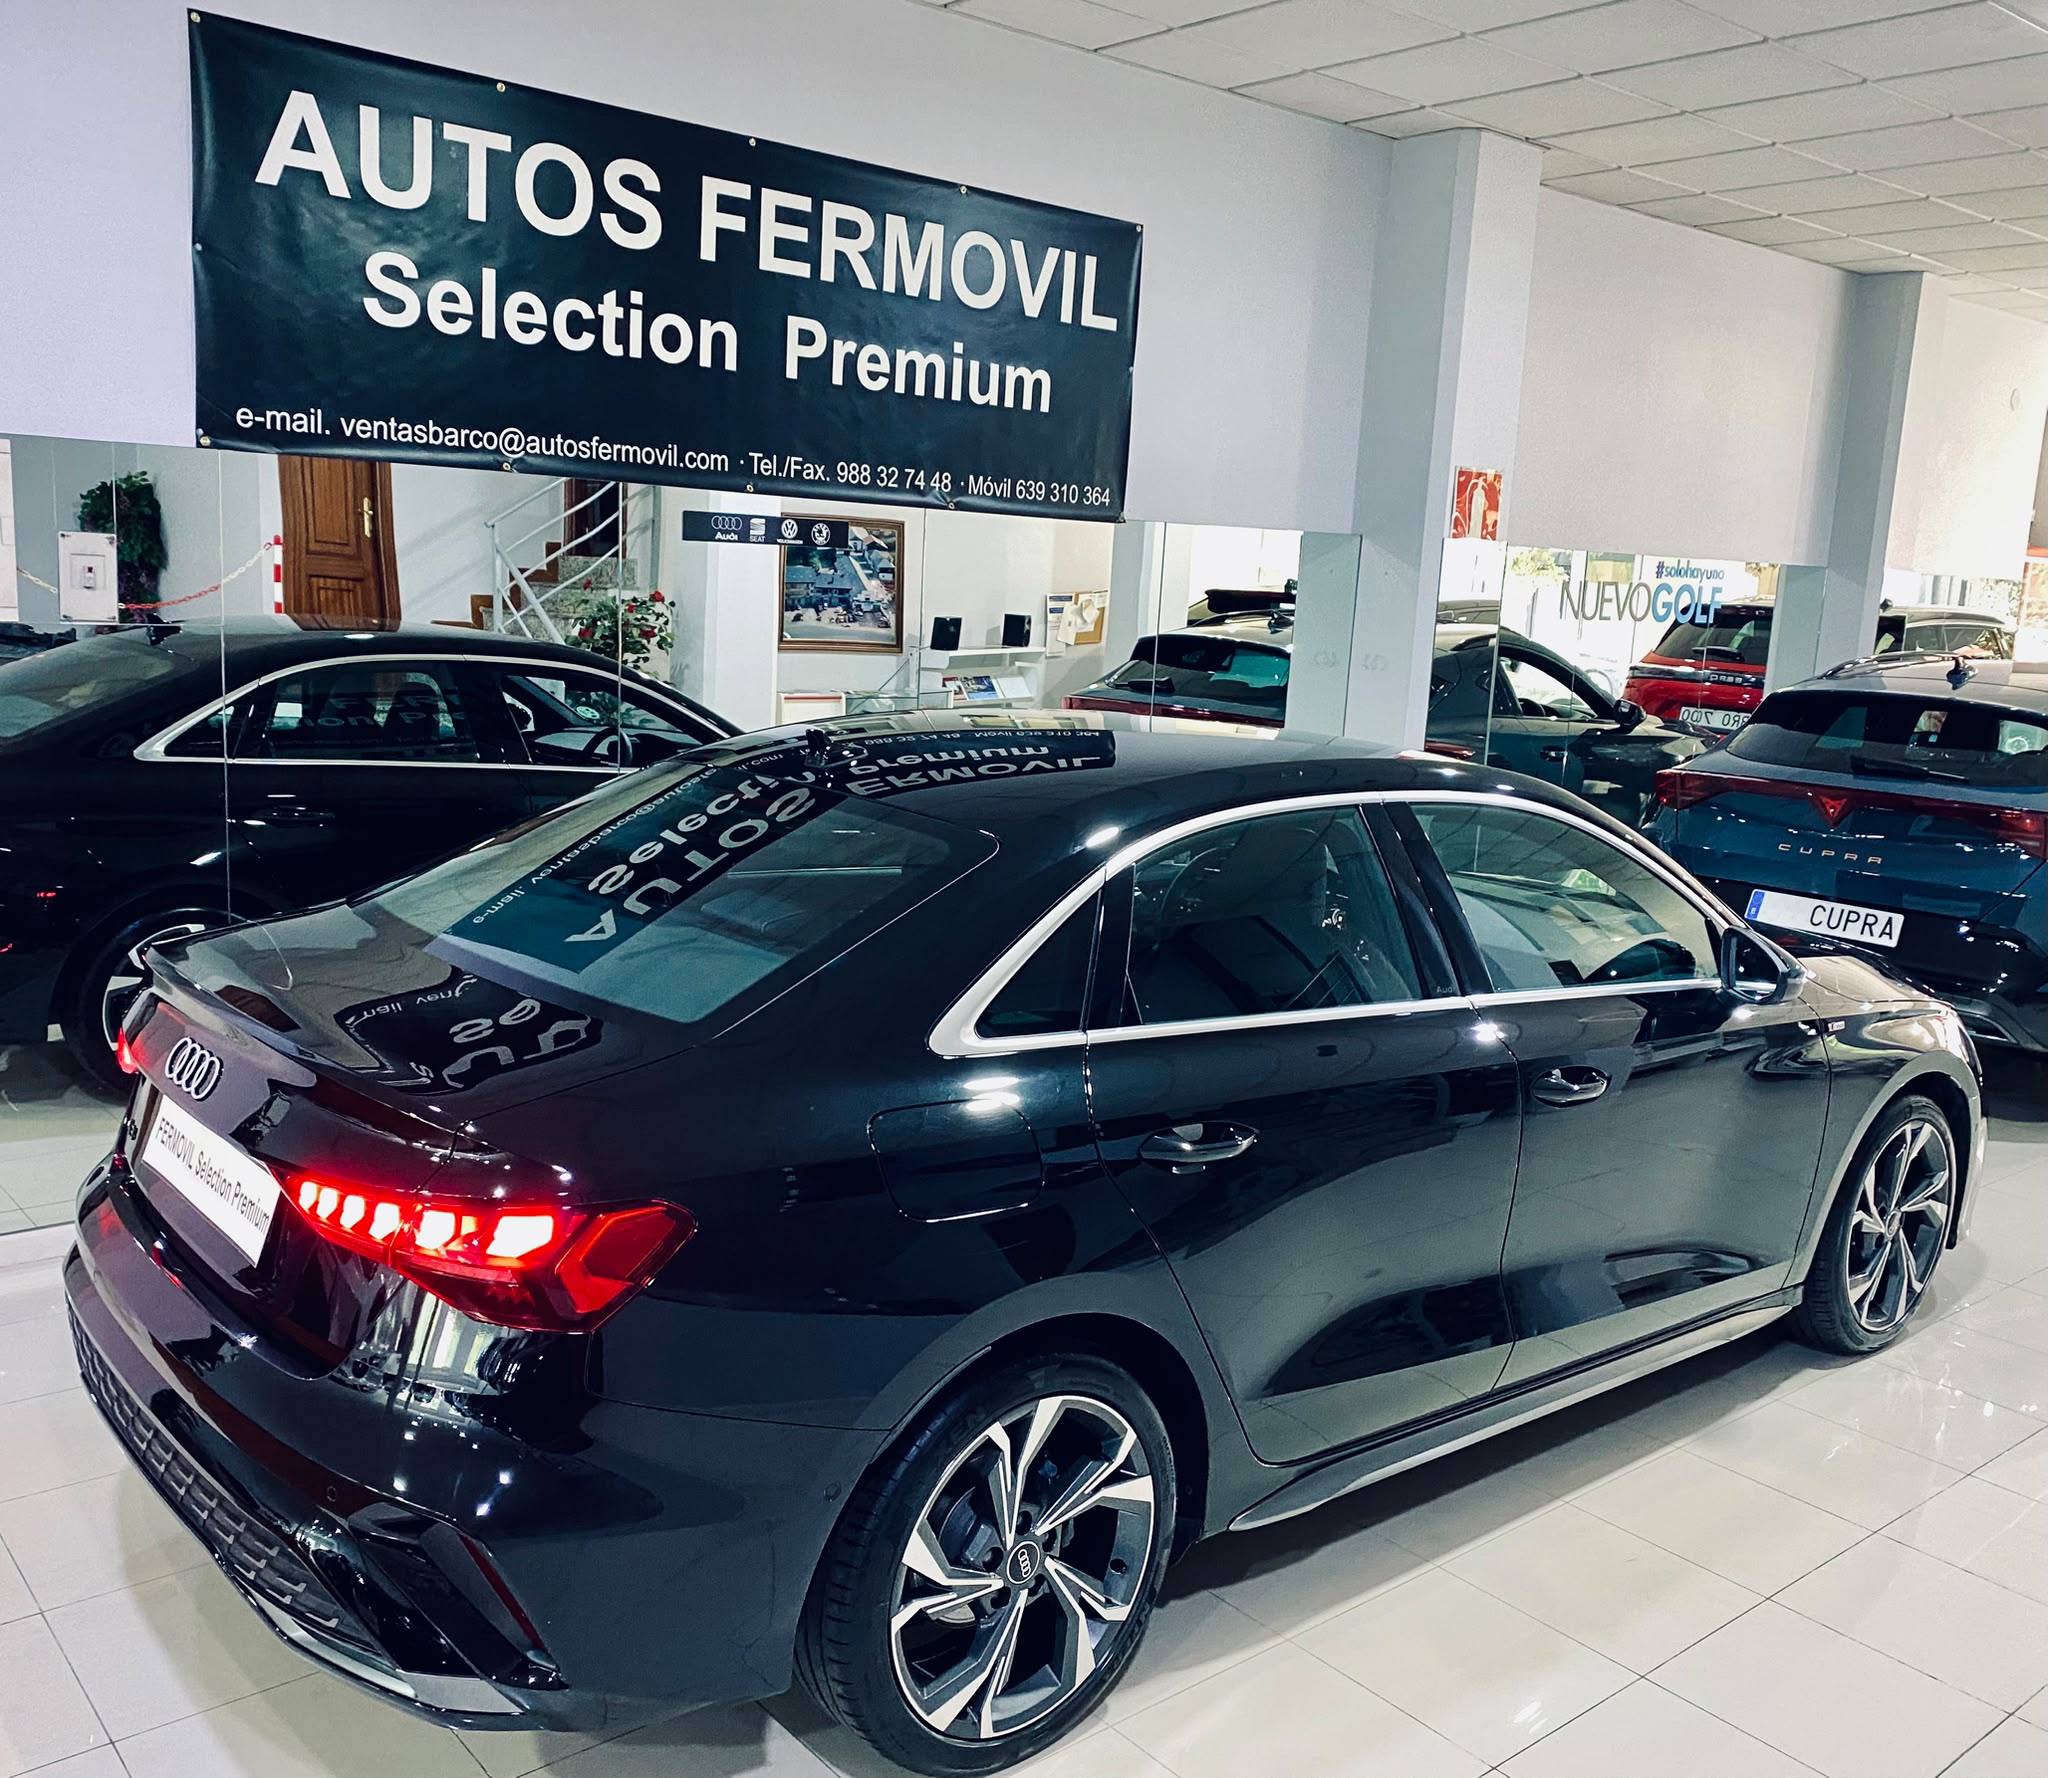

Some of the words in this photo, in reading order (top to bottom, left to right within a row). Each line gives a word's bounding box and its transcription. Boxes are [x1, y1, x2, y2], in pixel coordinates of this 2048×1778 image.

[255, 90, 662, 250] AUTOS
[700, 175, 1118, 332] FERMOVIL
[363, 250, 737, 372] Selection
[785, 315, 1052, 413] Premium
[236, 407, 331, 435] e-mail.
[340, 416, 729, 472] ventasbarco@autosfermovil.com
[749, 452, 831, 482] Tel./Fax.
[836, 461, 871, 485] 988
[876, 466, 899, 488] 32
[904, 468, 926, 490] 74
[929, 471, 952, 492] 48
[968, 474, 1012, 498] Móvil
[1015, 479, 1046, 500] 639
[1050, 482, 1079, 504] 310
[1083, 485, 1111, 507] 364
[714, 531, 739, 542] Audi
[750, 535, 766, 543] SEAT
[1655, 560, 1725, 583] #solohayuno
[1778, 843, 1883, 864] CUPRA
[1809, 905, 1894, 940] CUPRA
[155, 1117, 196, 1170] FERMOVIL
[195, 1151, 234, 1203] Selection
[233, 1181, 270, 1234] Premium
